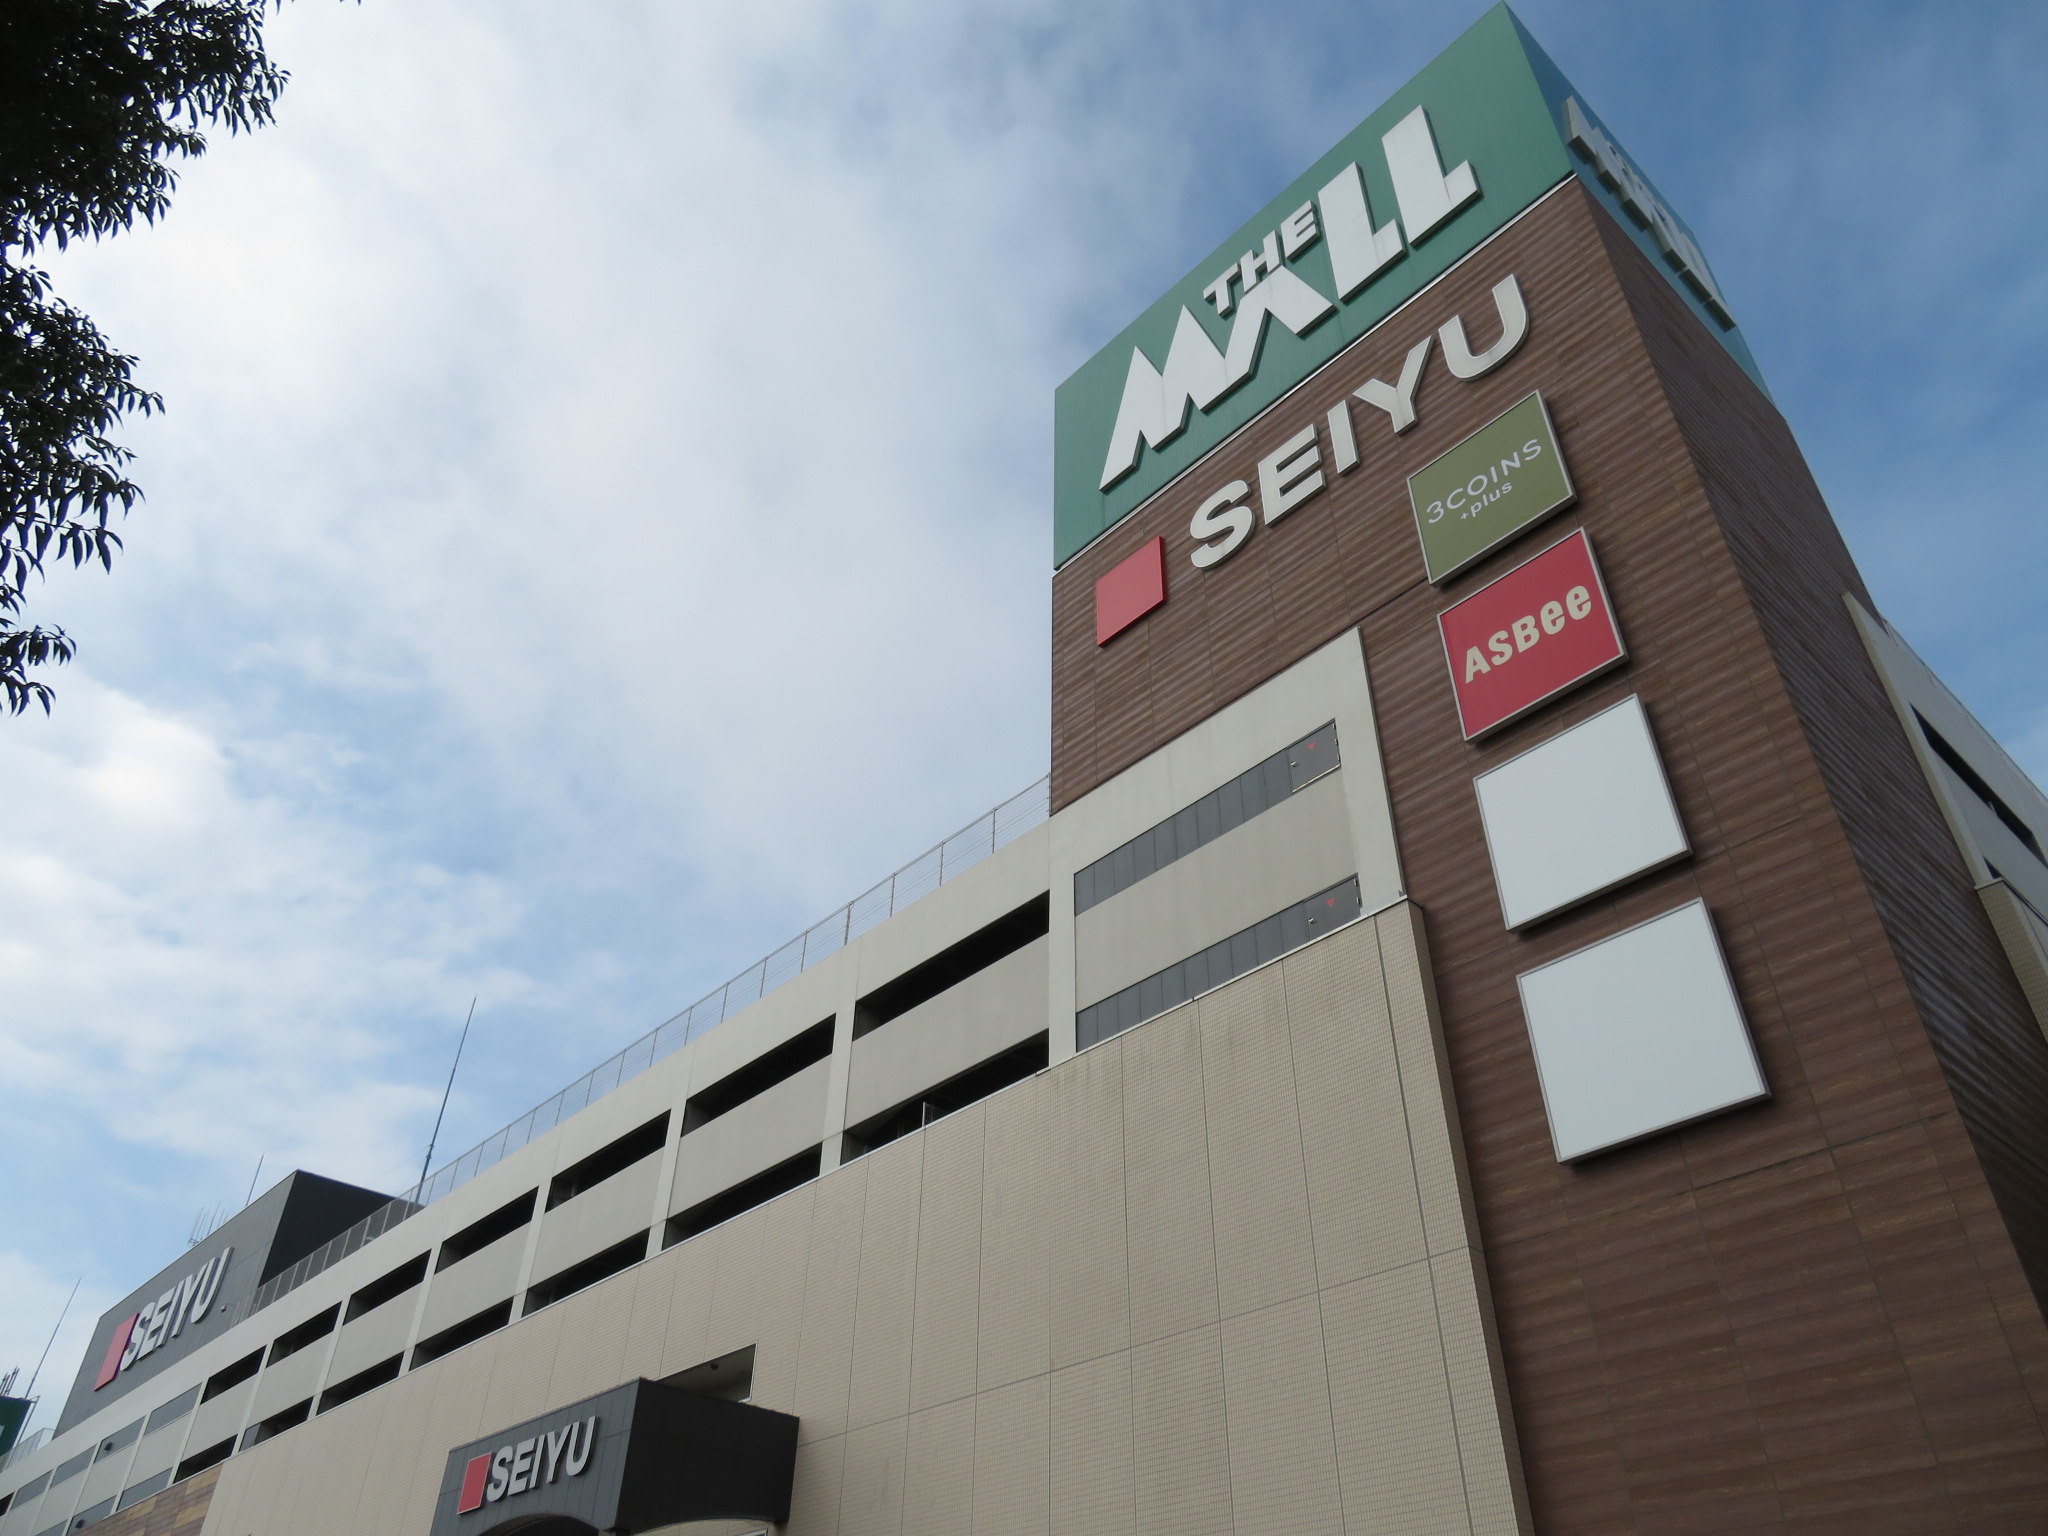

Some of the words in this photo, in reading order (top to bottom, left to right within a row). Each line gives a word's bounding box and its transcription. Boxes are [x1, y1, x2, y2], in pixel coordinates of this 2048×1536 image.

[1099, 104, 1482, 492] MALL
[1203, 199, 1321, 316] THE
[1189, 273, 1531, 570] SEIYU
[1426, 438, 1543, 524] 3COINS
[1465, 585, 1592, 684] ASBee
[120, 1246, 235, 1372] SEIYU
[486, 1416, 597, 1502] SEIYU
